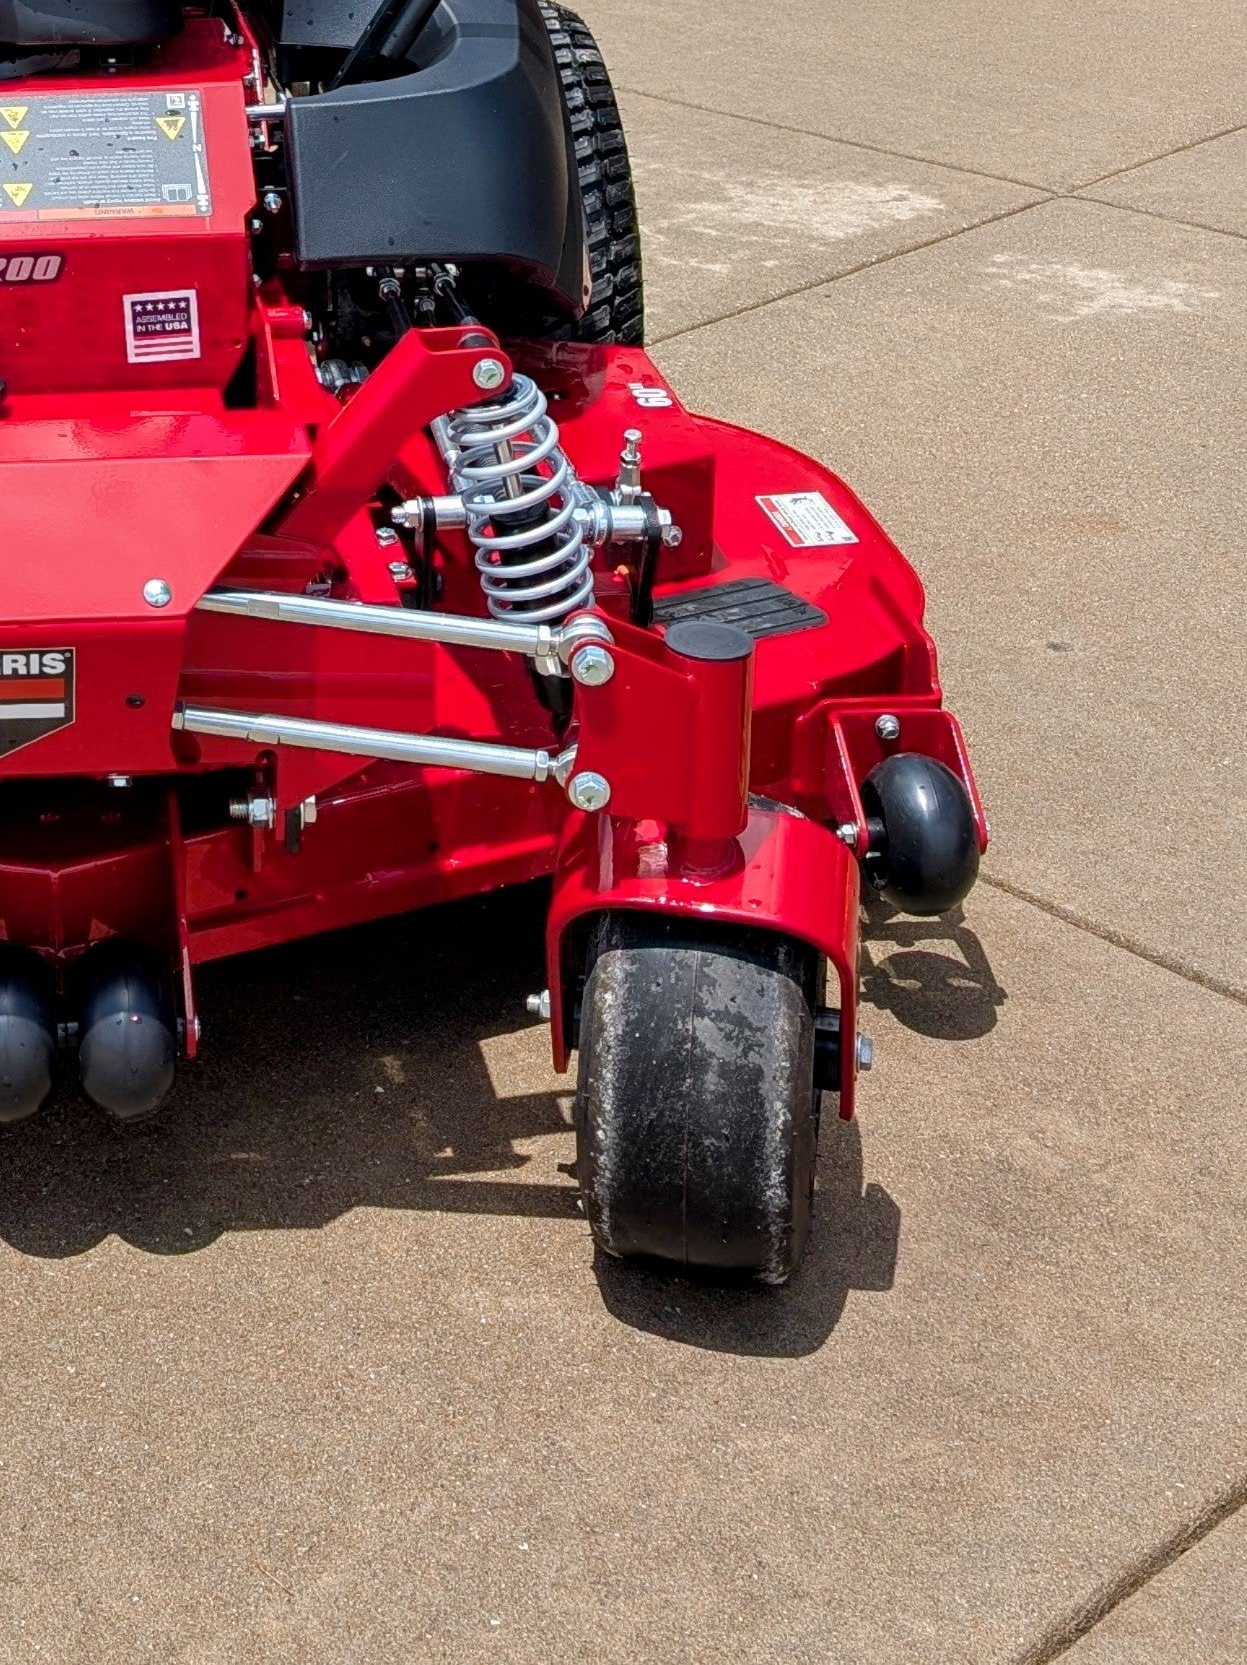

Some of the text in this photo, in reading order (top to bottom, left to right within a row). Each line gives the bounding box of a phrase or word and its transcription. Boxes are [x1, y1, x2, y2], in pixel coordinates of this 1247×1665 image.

[136, 313, 188, 323] ASSEMBLED
[147, 324, 163, 332] THE
[165, 321, 188, 330] USA
